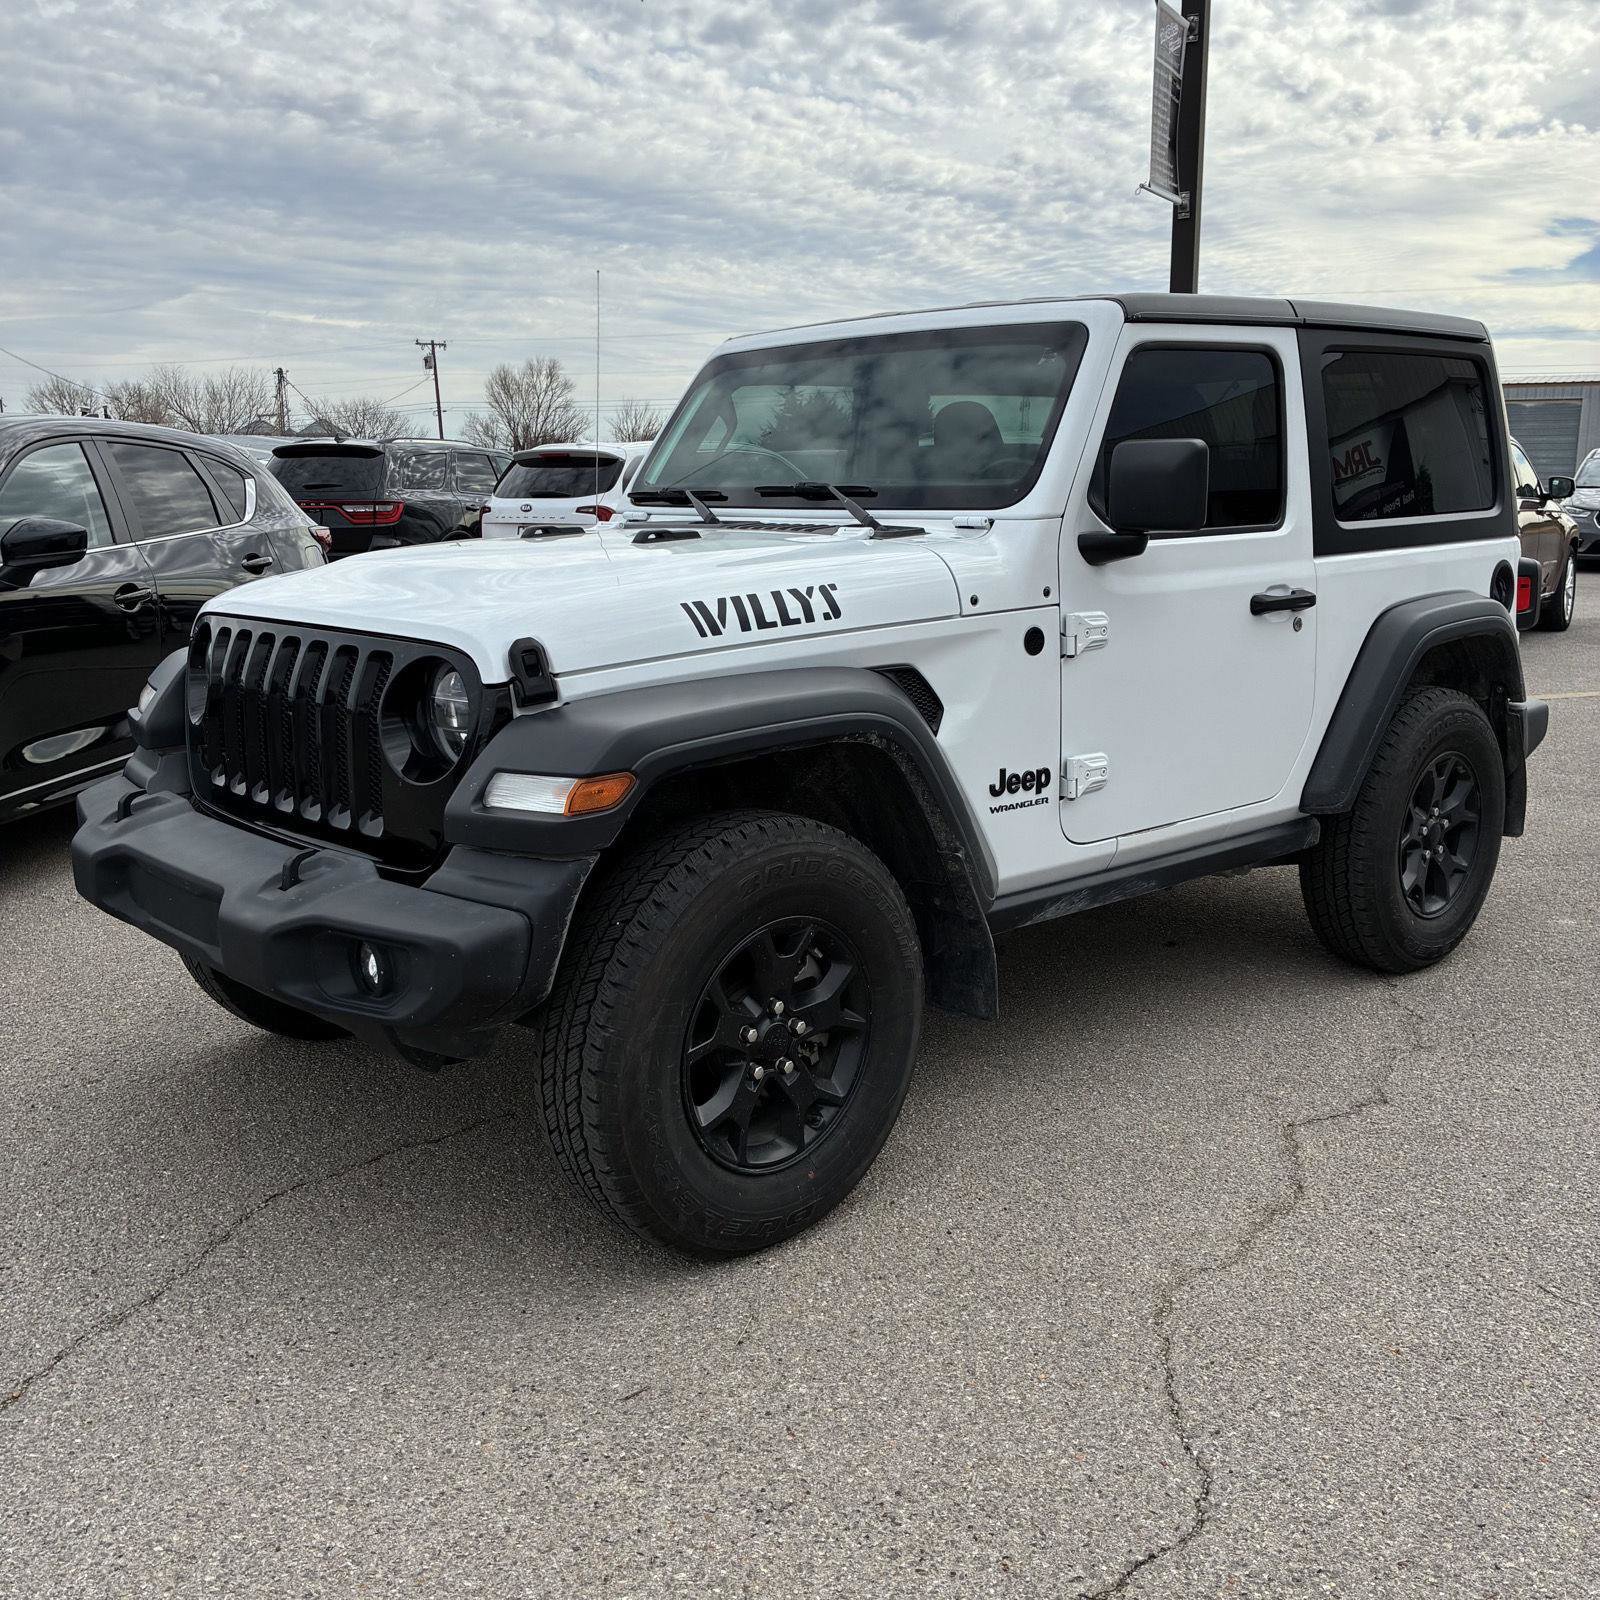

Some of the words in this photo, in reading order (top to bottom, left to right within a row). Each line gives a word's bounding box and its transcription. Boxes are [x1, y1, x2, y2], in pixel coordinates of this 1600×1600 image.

[680, 583, 842, 638] WILLYS
[989, 767, 1051, 797] Jeep
[989, 797, 1049, 814] WRANGLER
